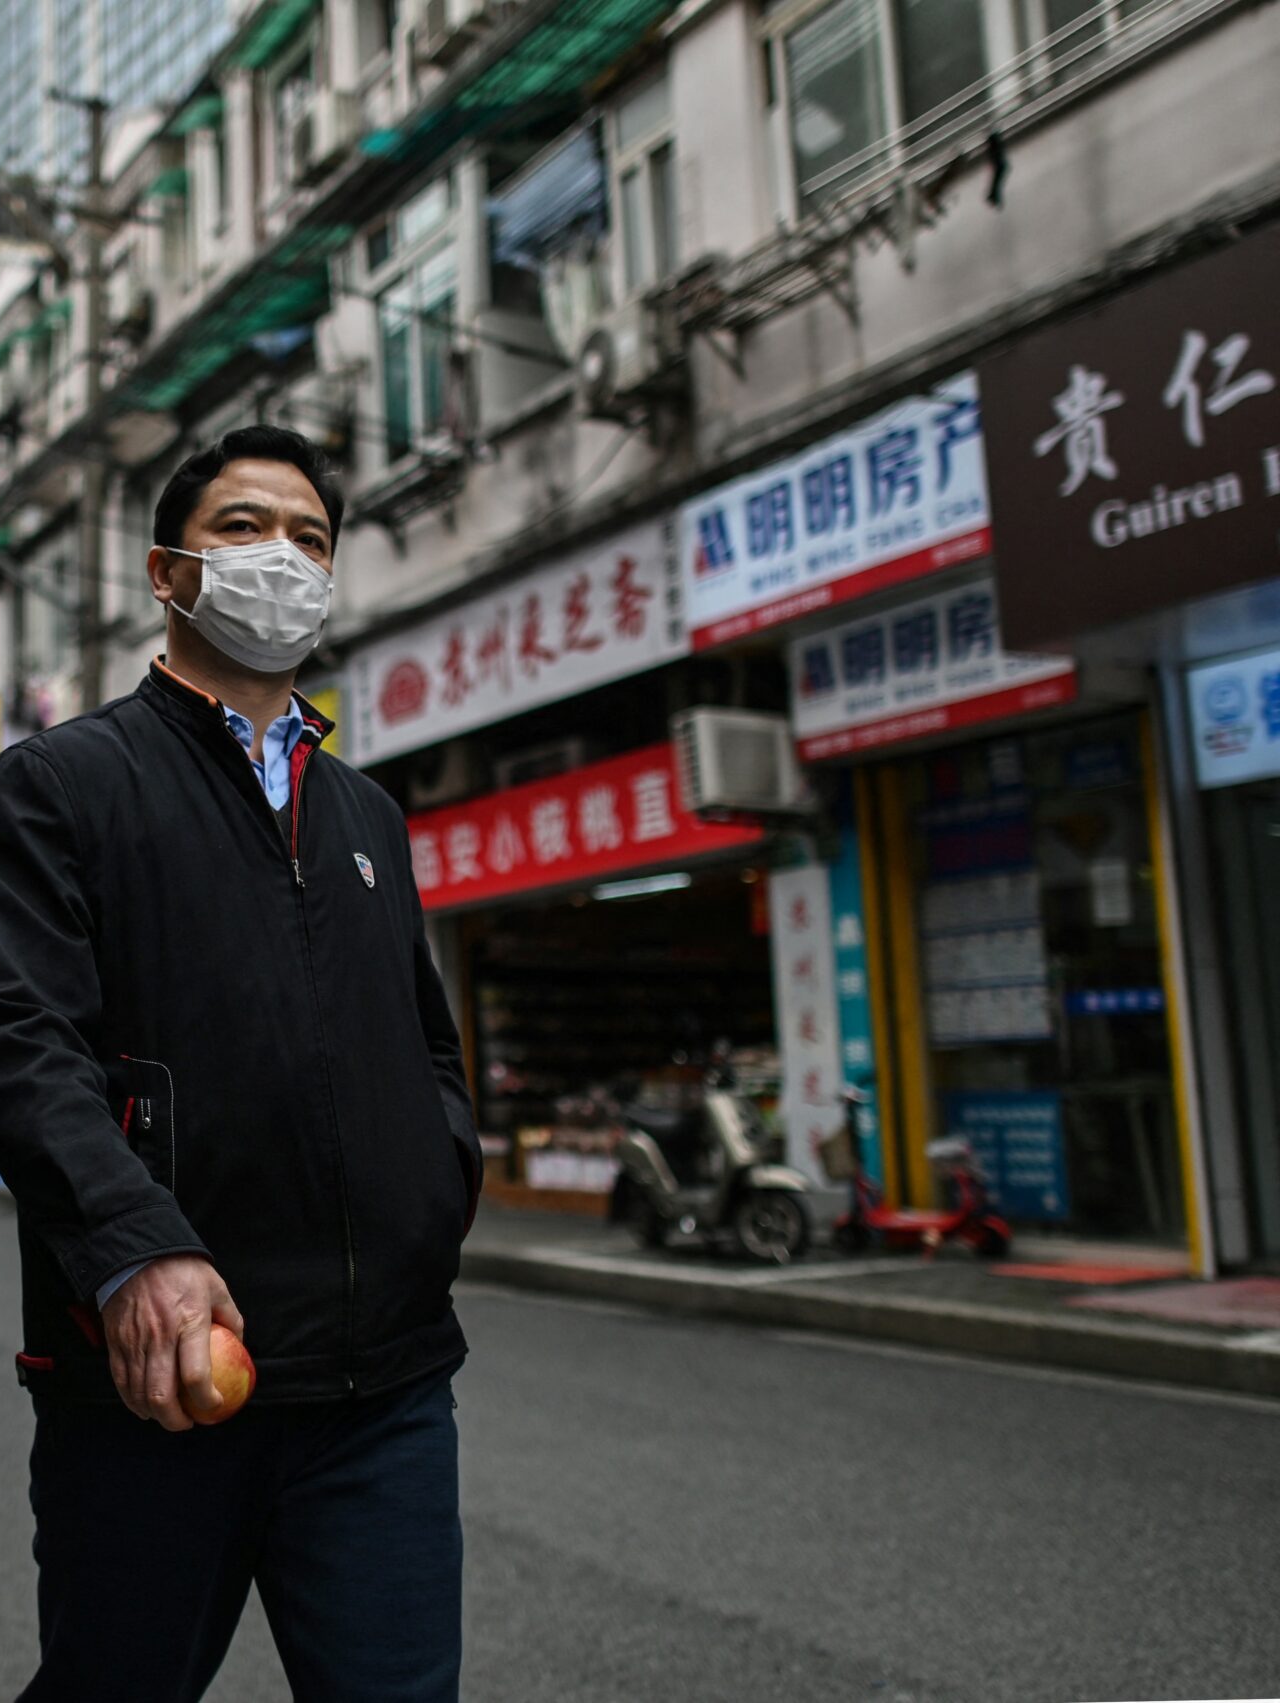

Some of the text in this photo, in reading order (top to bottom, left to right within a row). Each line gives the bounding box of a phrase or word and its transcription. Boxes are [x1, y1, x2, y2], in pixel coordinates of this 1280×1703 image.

[744, 396, 983, 558] 明明房产
[1091, 472, 1244, 549] Guiren
[411, 770, 702, 891] 临安小核桃直
